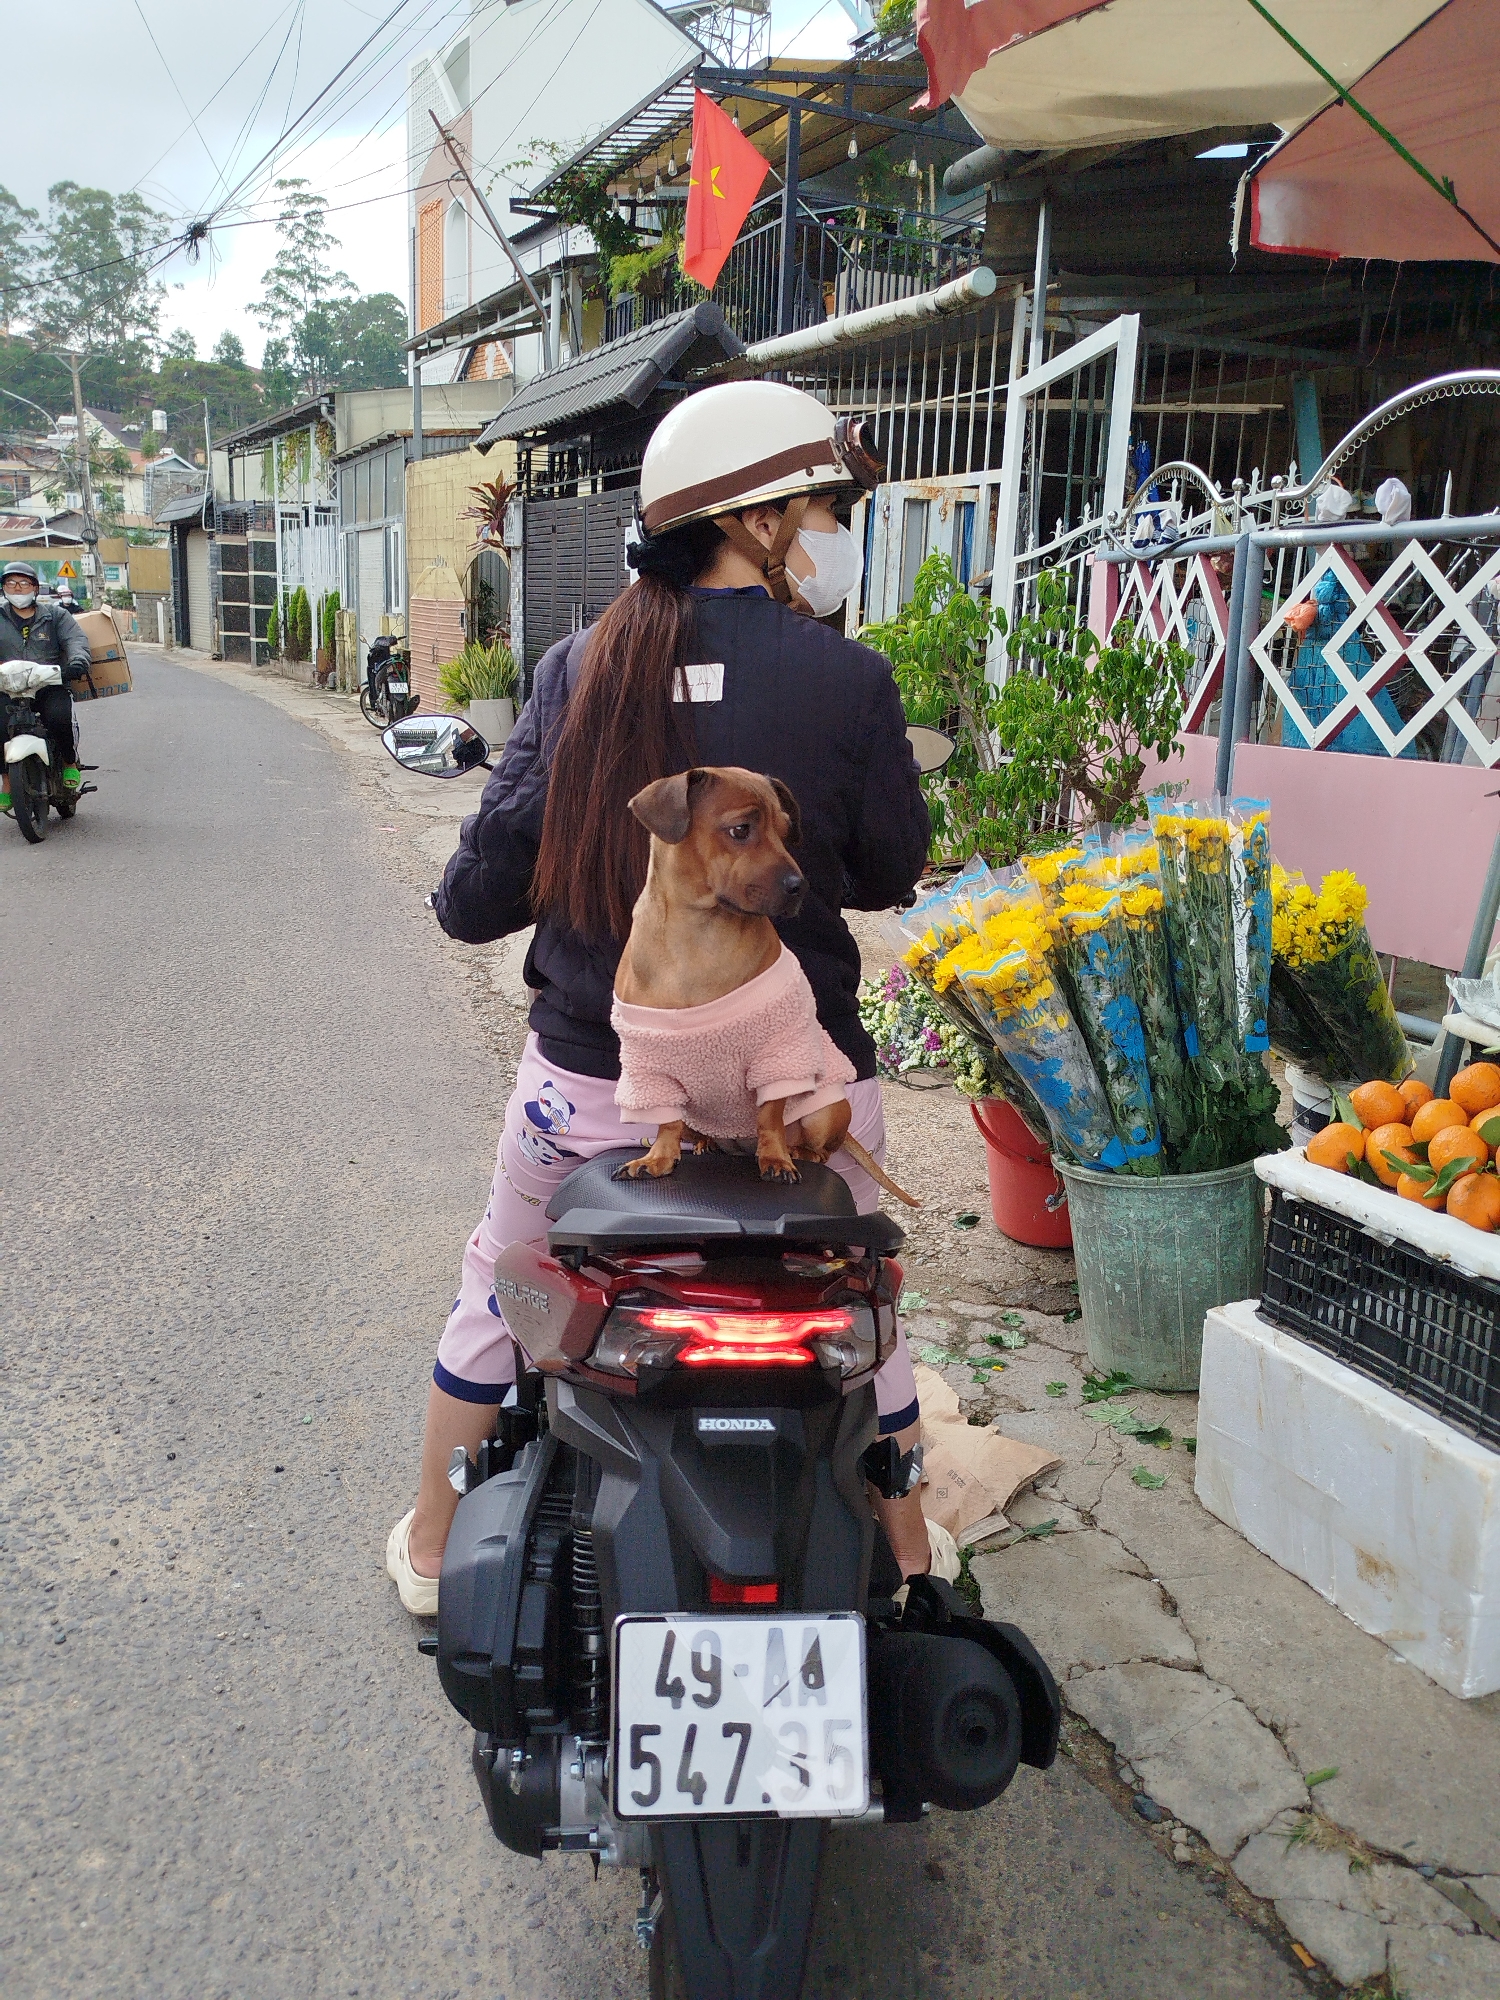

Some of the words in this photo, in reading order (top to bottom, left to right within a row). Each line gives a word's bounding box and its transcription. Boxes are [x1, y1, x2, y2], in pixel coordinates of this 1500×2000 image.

[698, 1418, 776, 1431] HONDA
[654, 1627, 828, 1710] 49-AA
[630, 1718, 855, 1808] 547.35
